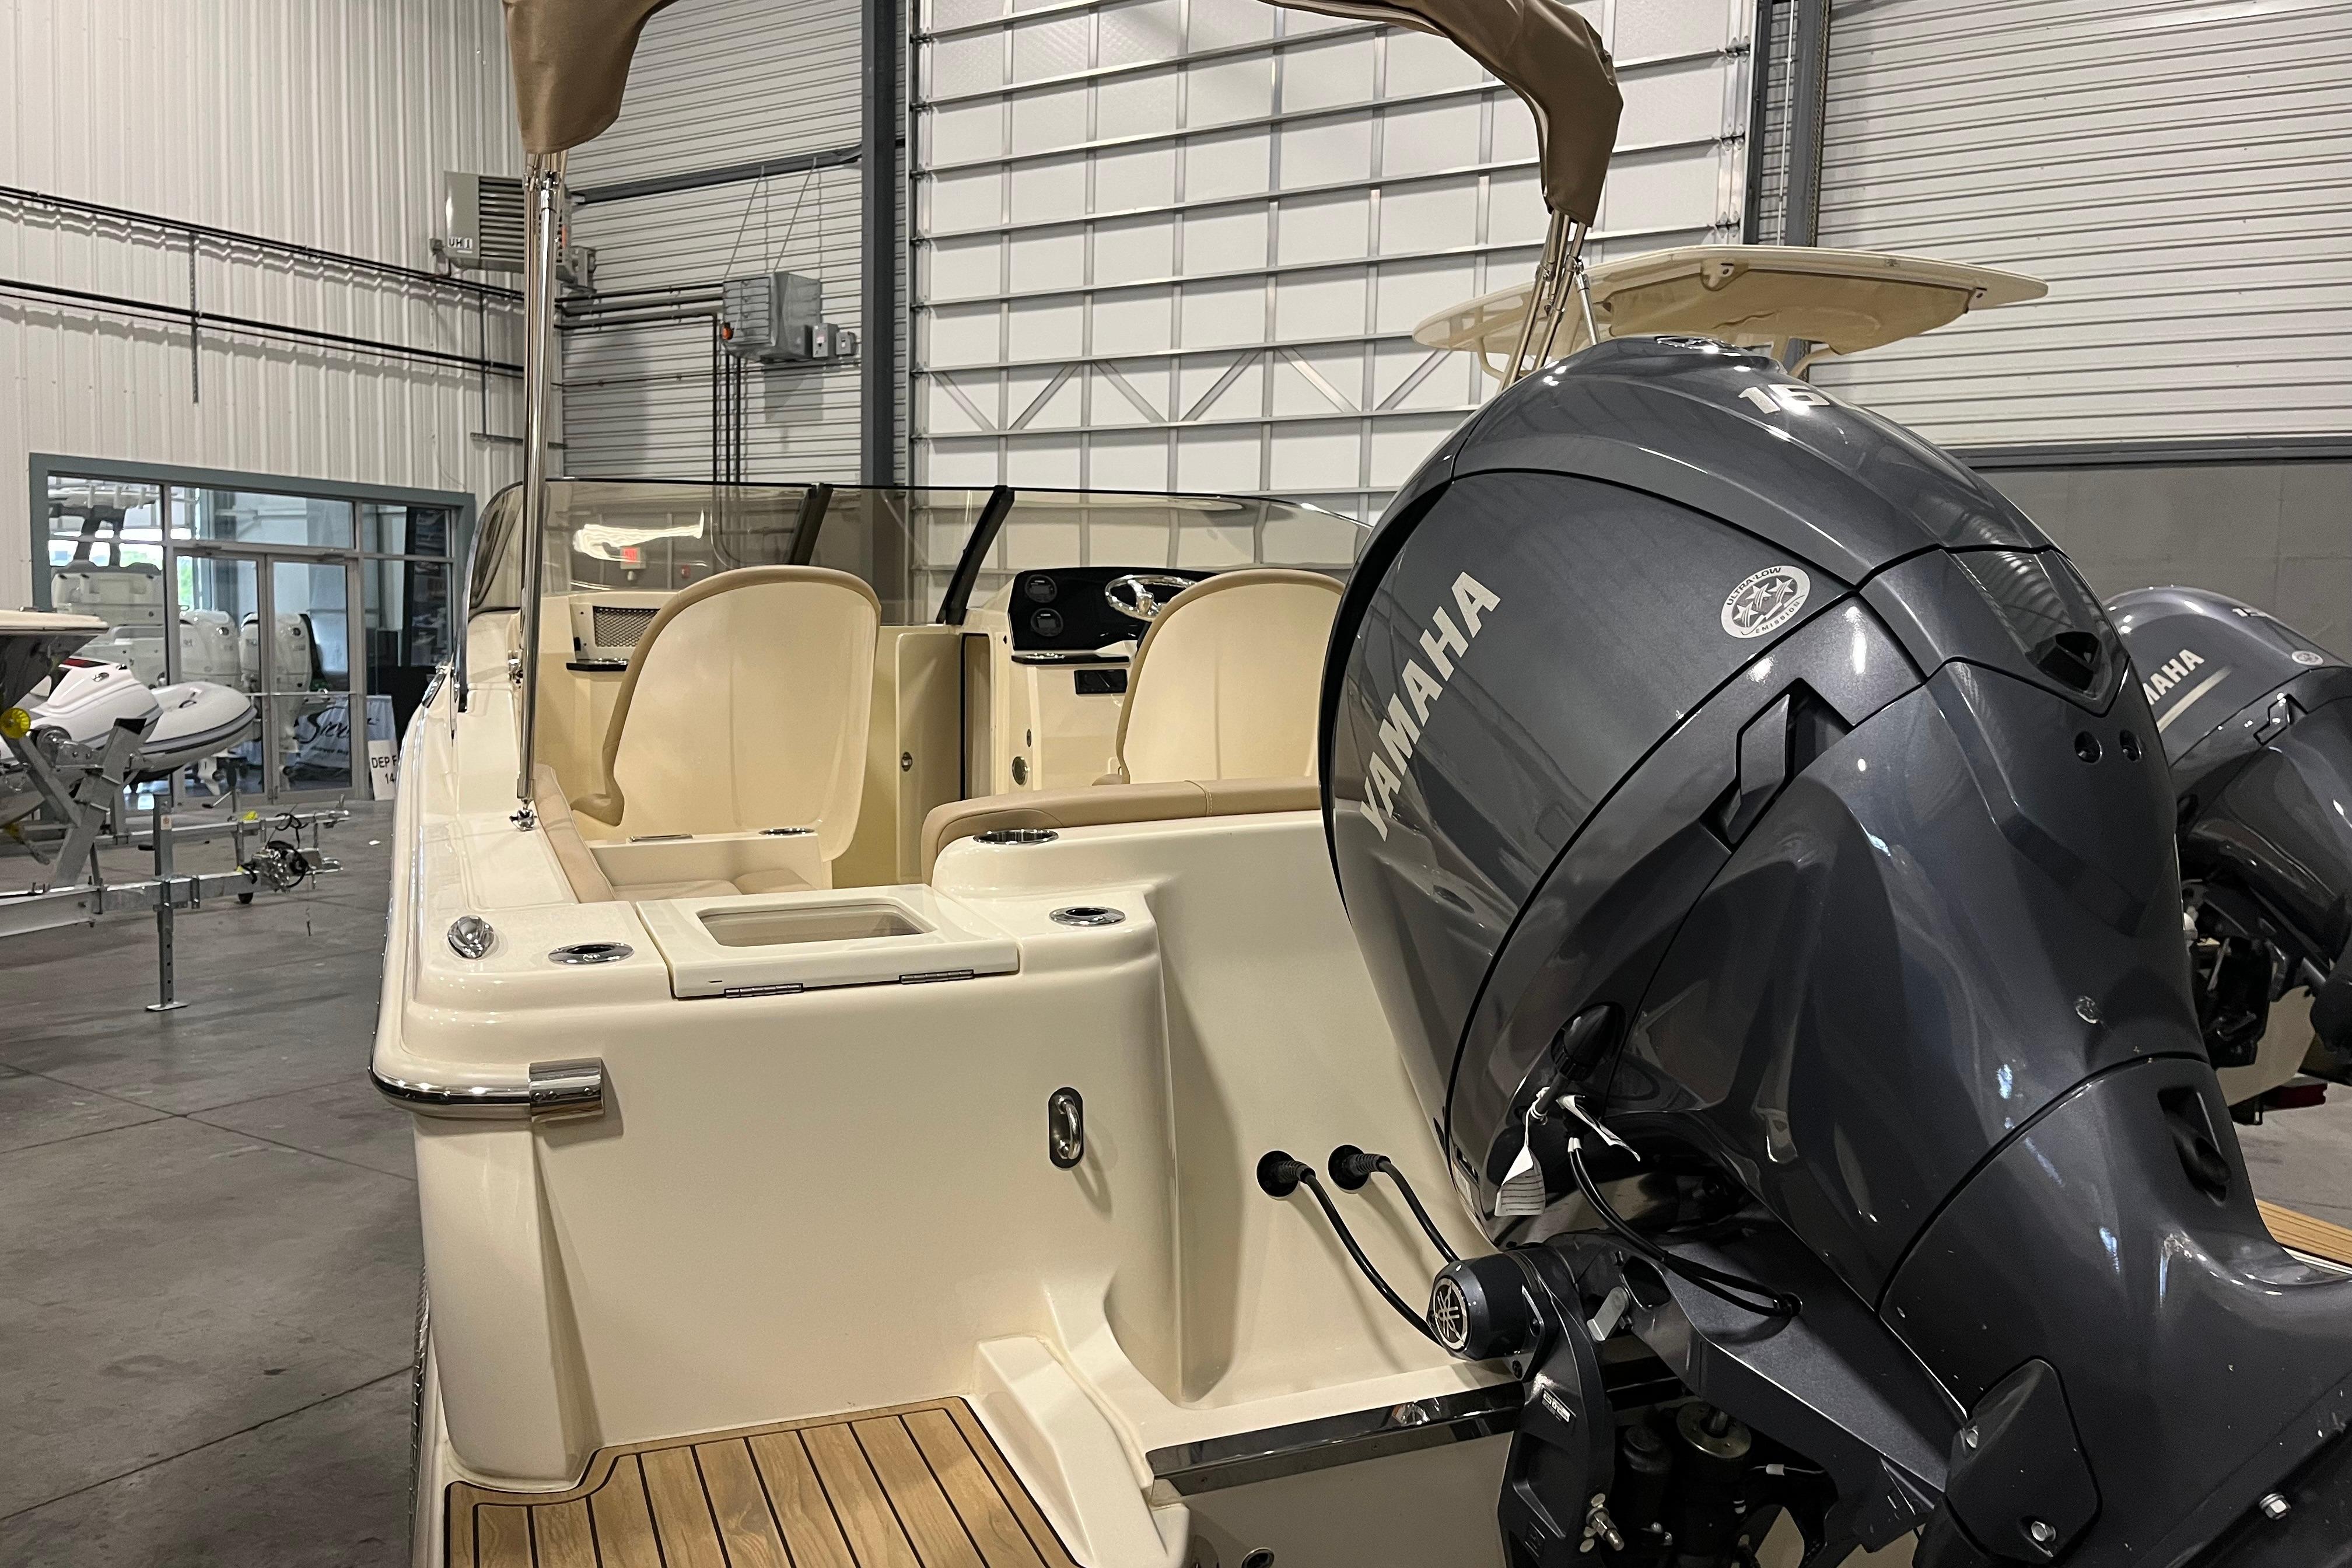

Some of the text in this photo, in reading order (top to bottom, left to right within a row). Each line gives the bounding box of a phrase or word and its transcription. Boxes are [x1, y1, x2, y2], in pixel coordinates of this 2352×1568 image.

[1755, 601, 1800, 634] EMISSION
[2142, 649, 2205, 706] MAHA
[1360, 571, 1501, 842] YAMAHA
[371, 757, 390, 768] DEP
